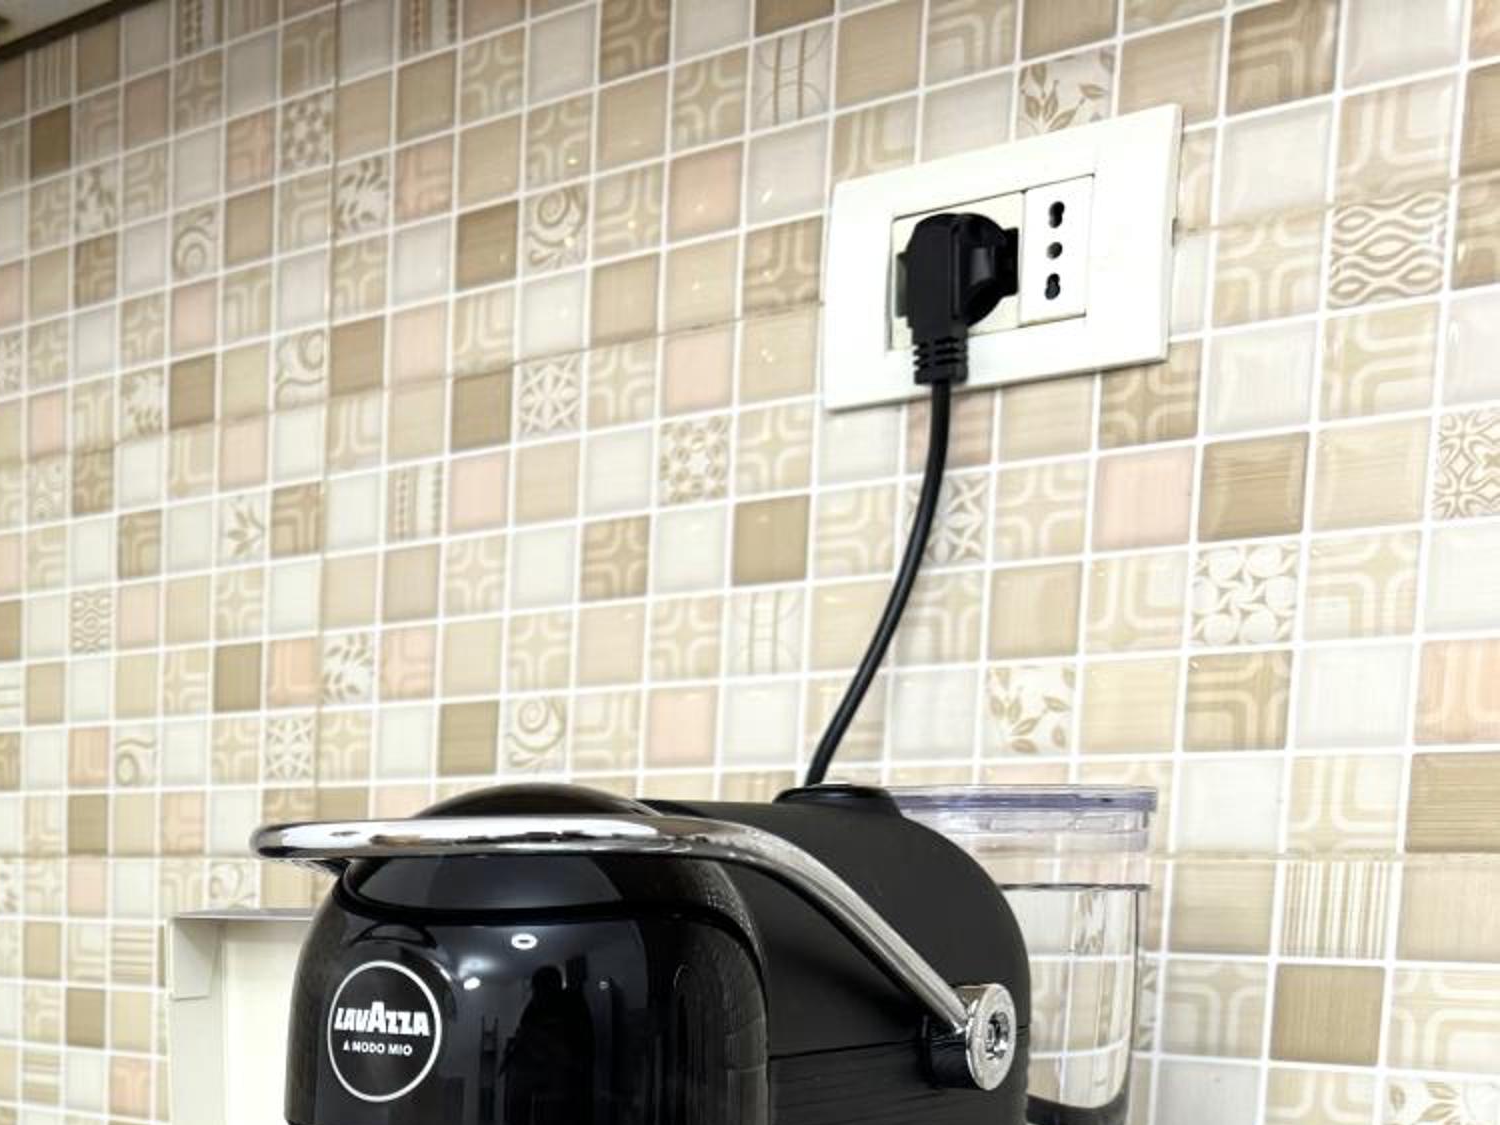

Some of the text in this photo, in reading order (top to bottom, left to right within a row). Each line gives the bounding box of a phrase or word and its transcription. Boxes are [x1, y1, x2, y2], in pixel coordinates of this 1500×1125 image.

[334, 1001, 430, 1036] LAVAZZA
[342, 1040, 413, 1056] A MODO MIO
